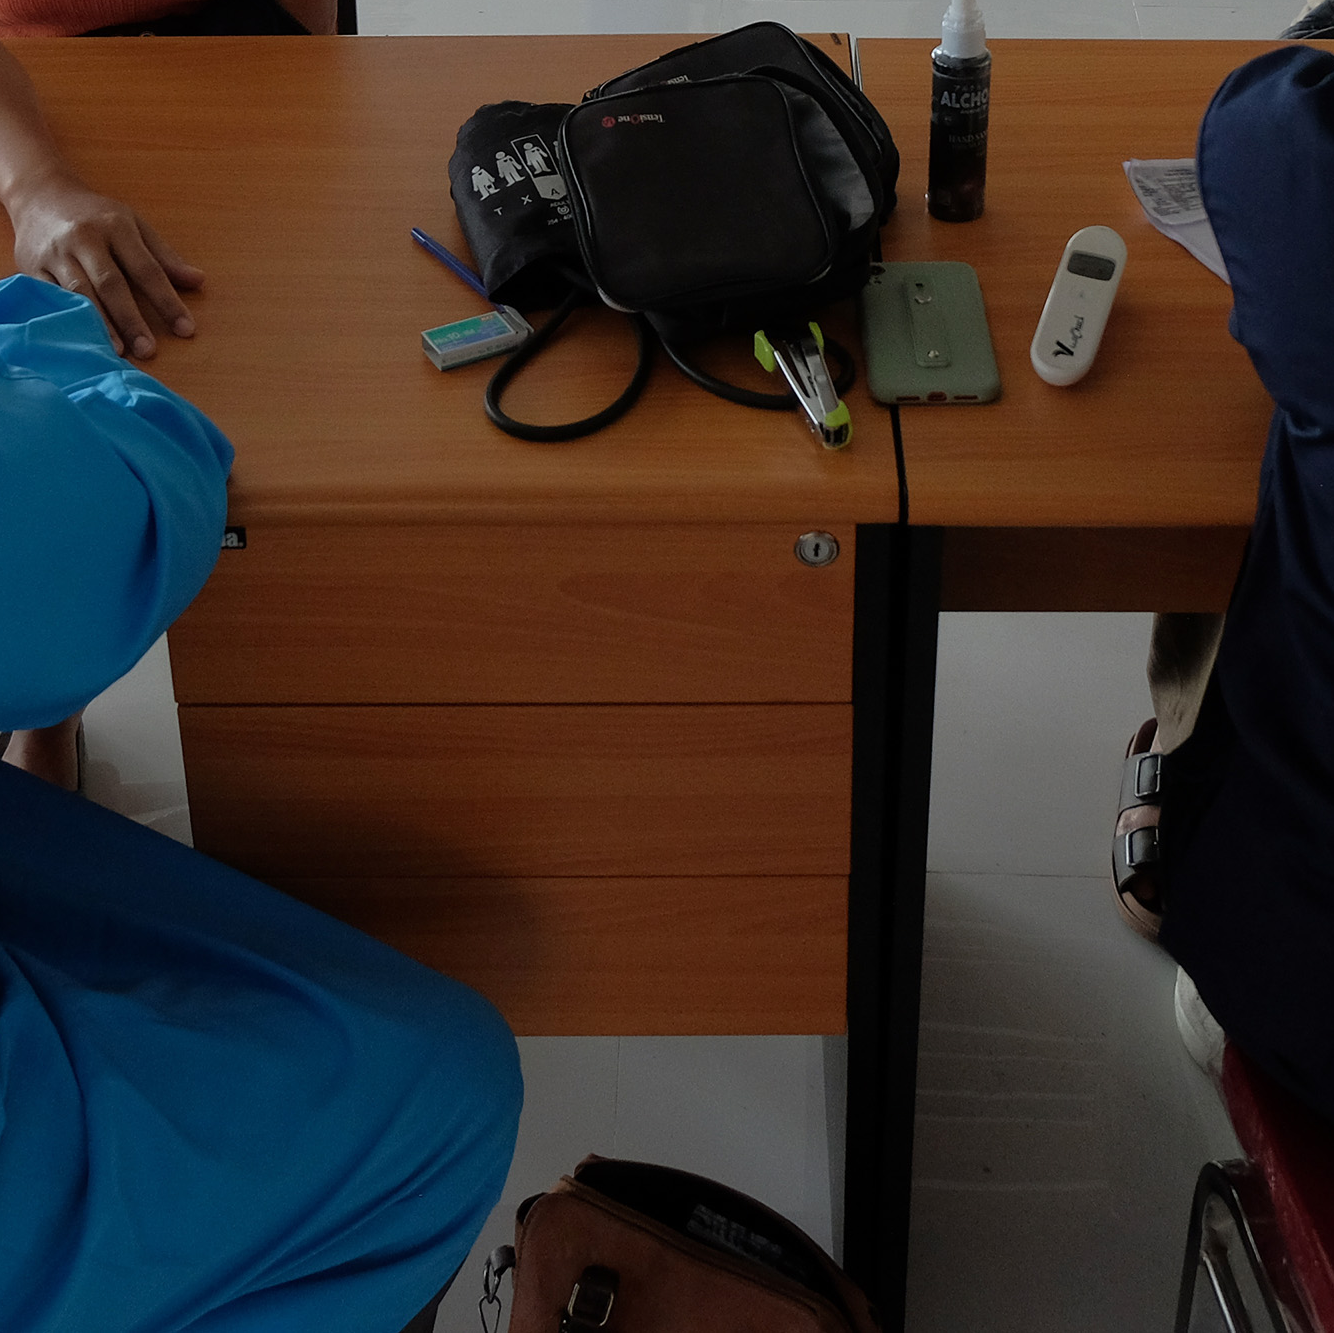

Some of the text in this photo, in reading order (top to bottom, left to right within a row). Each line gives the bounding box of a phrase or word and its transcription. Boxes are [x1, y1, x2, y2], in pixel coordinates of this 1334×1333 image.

[616, 113, 665, 125] TensiOne
[520, 194, 533, 205] X
[493, 207, 503, 216] T
